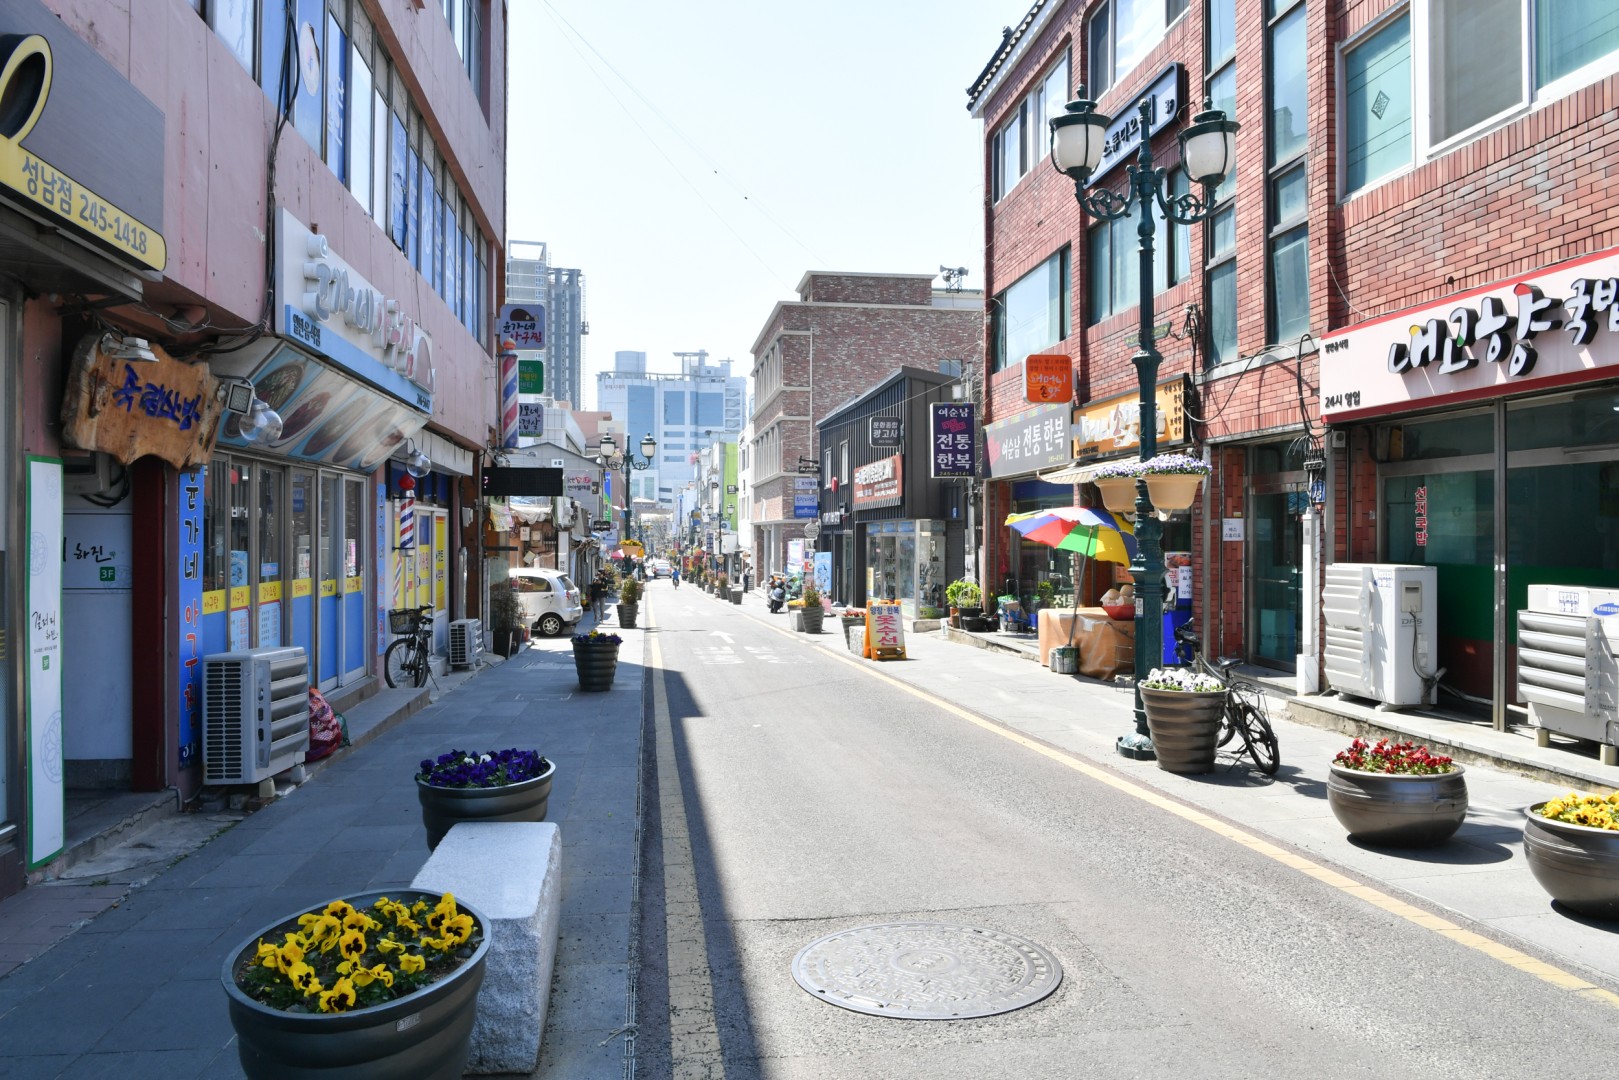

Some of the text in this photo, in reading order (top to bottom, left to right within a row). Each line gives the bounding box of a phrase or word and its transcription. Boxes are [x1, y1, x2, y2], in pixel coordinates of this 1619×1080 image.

[22, 156, 147, 255] 성남점 245-1418
[503, 320, 536, 334] 윤가네
[1325, 391, 1361, 408] 24시 영업
[872, 429, 898, 438] 광고사
[937, 433, 971, 450] 전통
[1022, 423, 1041, 457] 전통
[1043, 416, 1065, 452] 한복
[937, 453, 972, 469] 한복
[1414, 486, 1428, 546] 선지국밥
[101, 569, 114, 579] 3F
[875, 614, 898, 646] 옷수선
